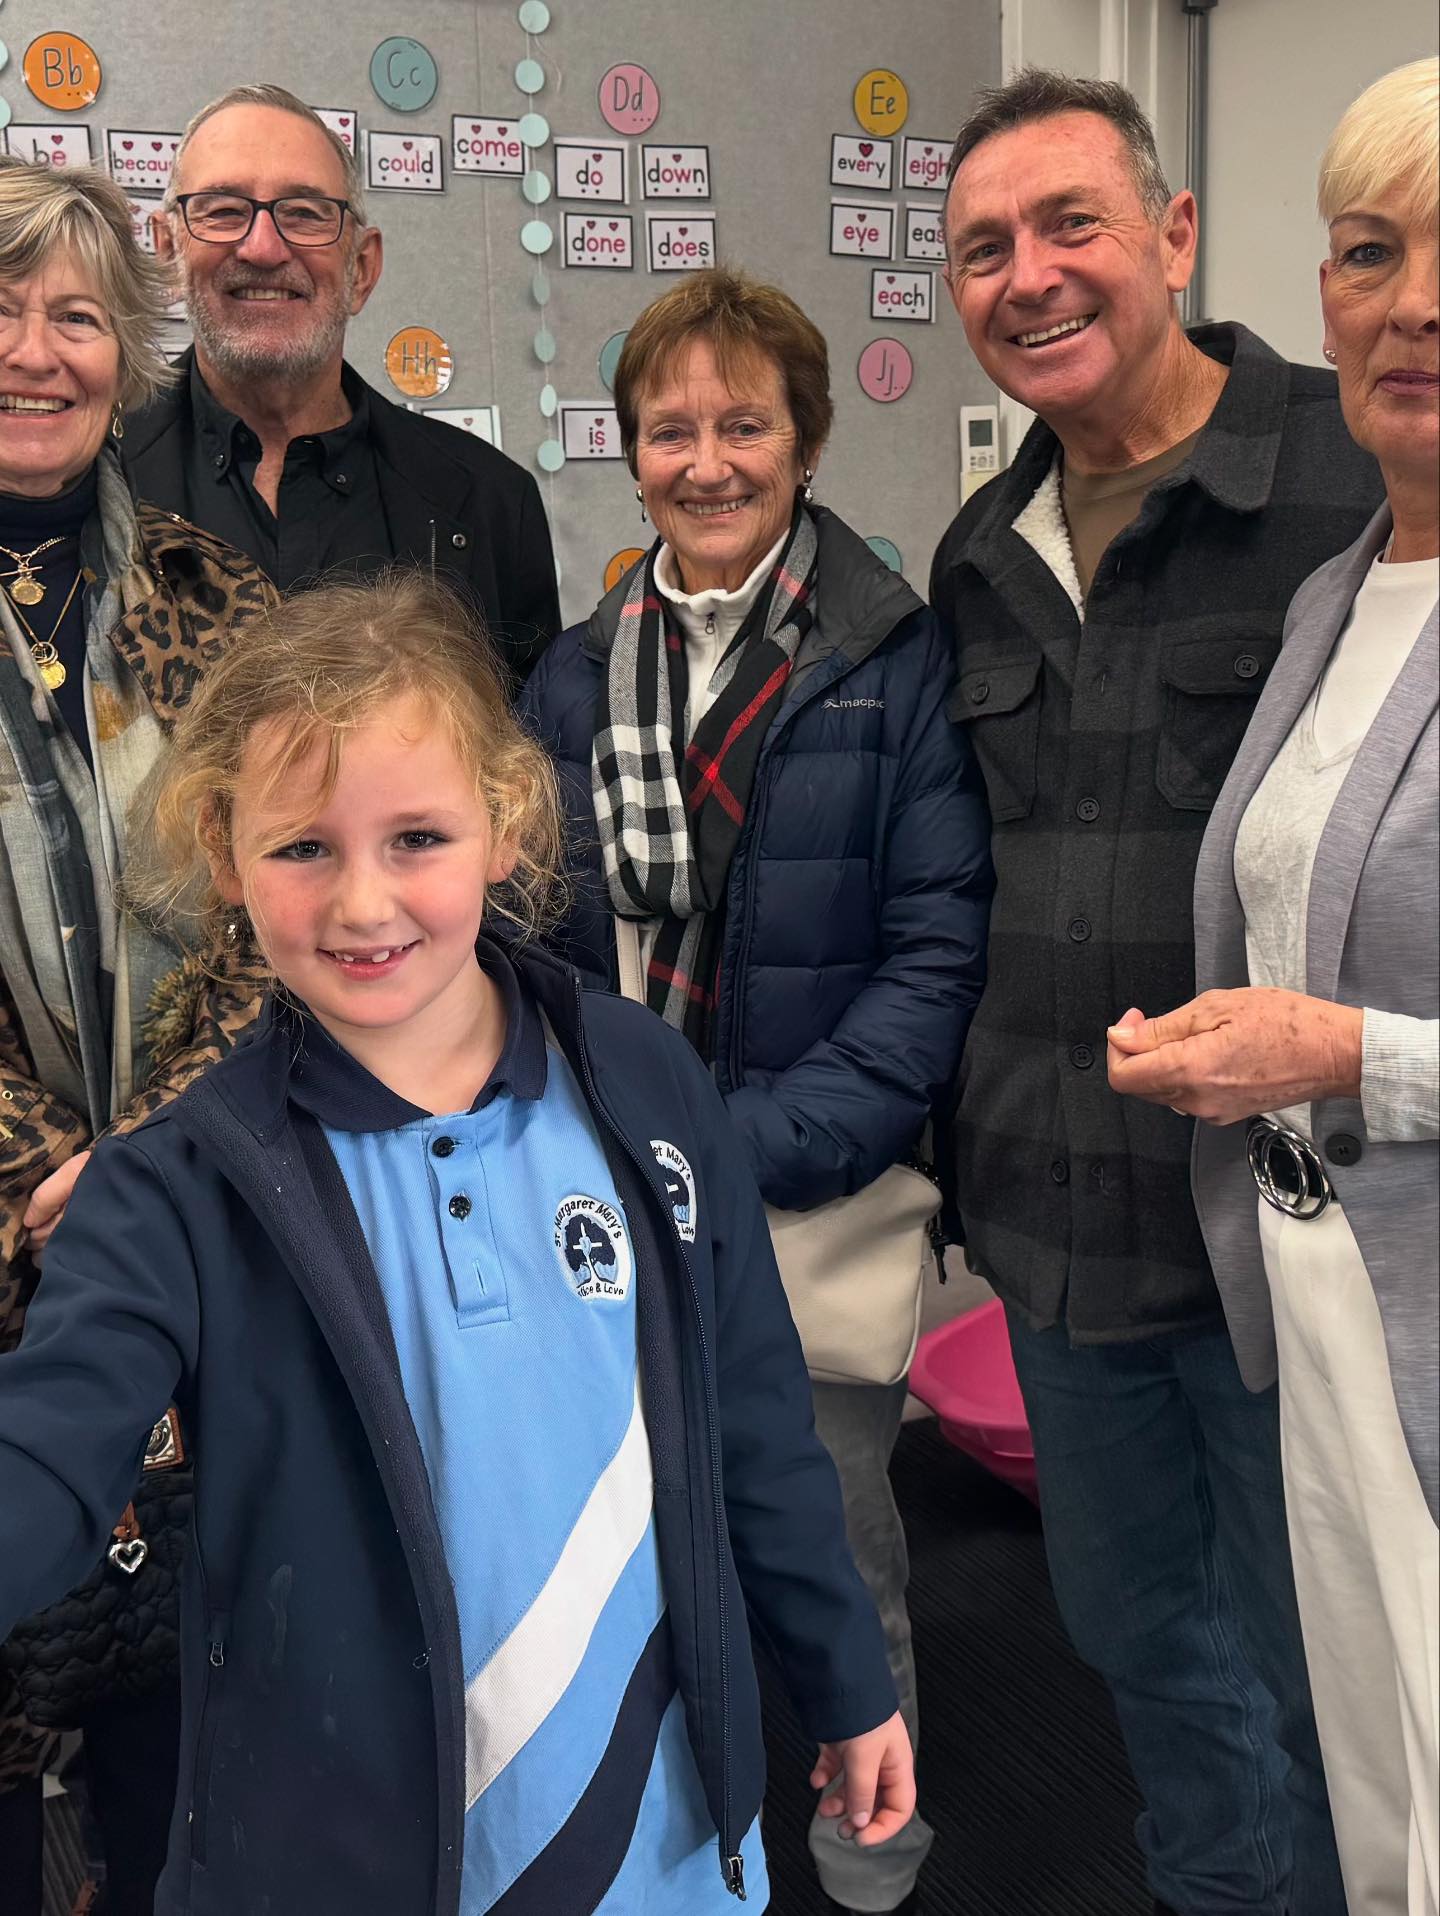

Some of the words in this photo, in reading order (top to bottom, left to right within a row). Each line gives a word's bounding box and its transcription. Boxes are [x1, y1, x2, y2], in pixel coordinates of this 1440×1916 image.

[44, 47, 82, 87] Bb
[387, 51, 421, 88] Cc
[613, 76, 643, 111] Dd
[870, 80, 896, 115] Ee
[32, 138, 66, 166] be
[456, 139, 520, 157] come
[113, 151, 173, 171] becau
[378, 150, 433, 173] could
[576, 159, 603, 185] do
[648, 158, 704, 183] down
[837, 157, 885, 178] every
[909, 152, 950, 181] eigh
[572, 226, 625, 253] done
[658, 232, 709, 256] does
[843, 226, 879, 247] eye
[912, 227, 945, 243] eas
[878, 283, 925, 306] each
[402, 341, 437, 375] Hh
[589, 427, 605, 445] is
[554, 1199, 595, 1230] Margaret
[595, 1203, 622, 1239] Mary's
